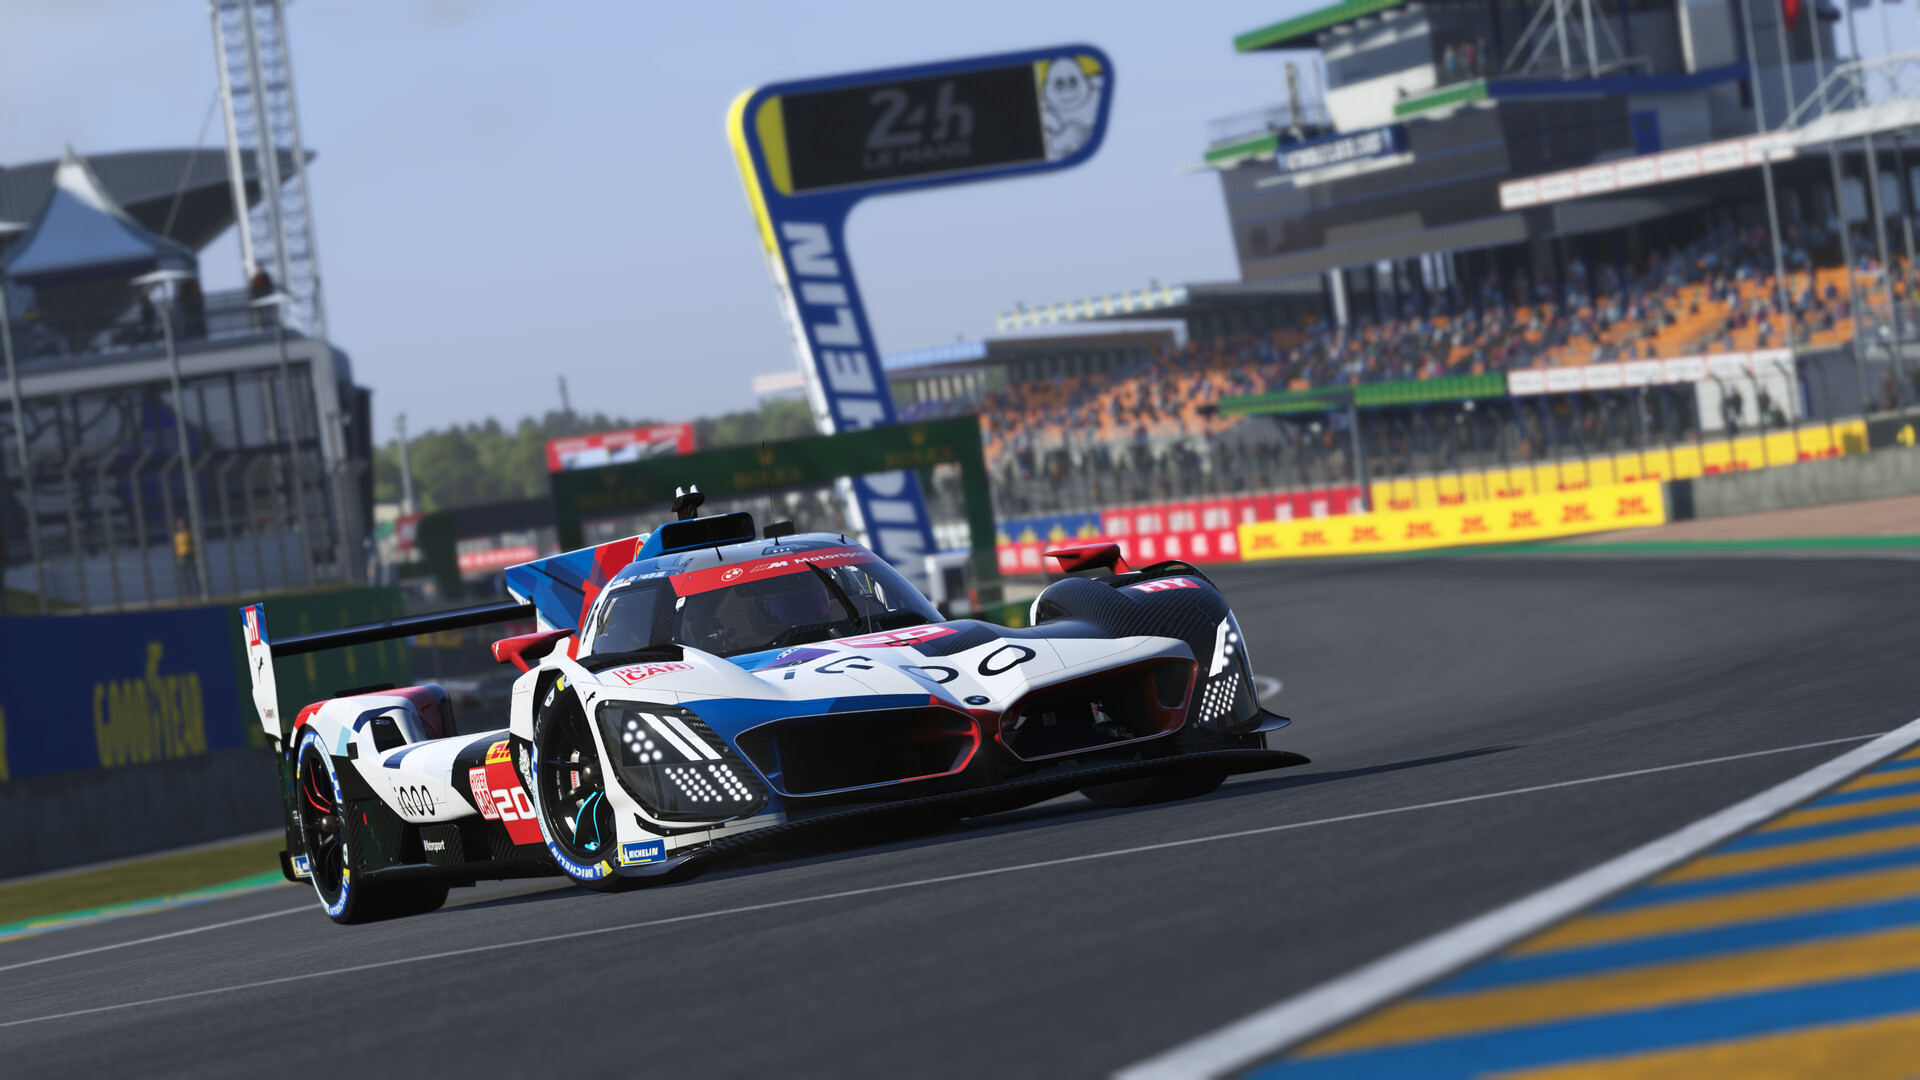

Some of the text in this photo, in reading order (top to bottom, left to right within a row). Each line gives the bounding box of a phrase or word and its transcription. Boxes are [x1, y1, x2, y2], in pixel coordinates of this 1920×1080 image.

[1138, 577, 1187, 592] HY
[245, 609, 260, 641] HY
[625, 664, 686, 681] CAR
[491, 743, 510, 760] DH
[471, 772, 486, 790] HYPER
[474, 789, 498, 815] CAR
[491, 786, 537, 822] 20
[551, 846, 594, 878] MICHELIN
[628, 847, 659, 859] MICHELIN
